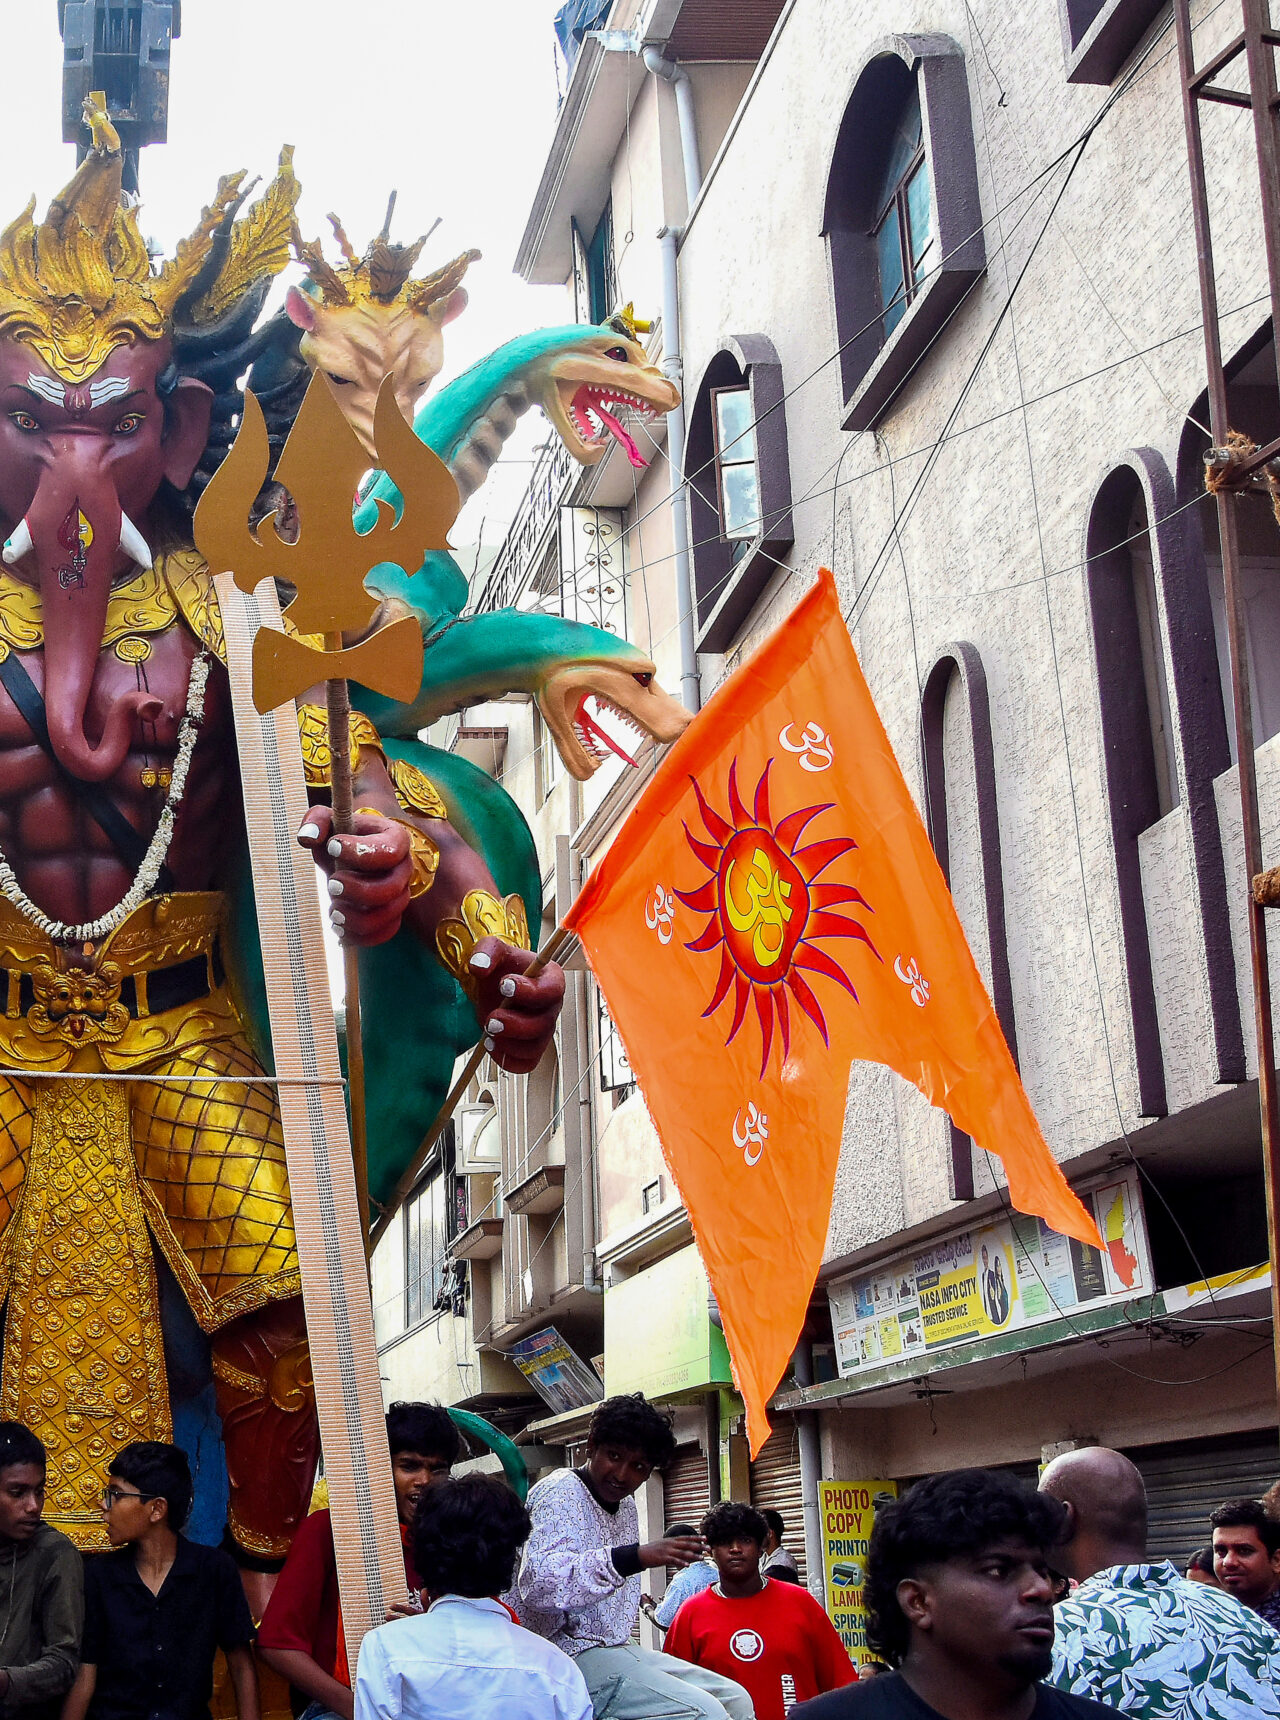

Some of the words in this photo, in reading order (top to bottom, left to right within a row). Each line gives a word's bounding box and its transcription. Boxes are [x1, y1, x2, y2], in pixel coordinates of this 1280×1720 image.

[919, 1289, 941, 1311] NASA
[941, 1283, 959, 1305] INFO
[959, 1277, 977, 1299] CITY
[922, 1310, 946, 1327] TRUSTED
[946, 1303, 968, 1321] SERVICE
[823, 1488, 870, 1510] PHOTO
[826, 1512, 863, 1534] COPY
[828, 1539, 870, 1556] PRINTO
[839, 1631, 867, 1648] INDI
